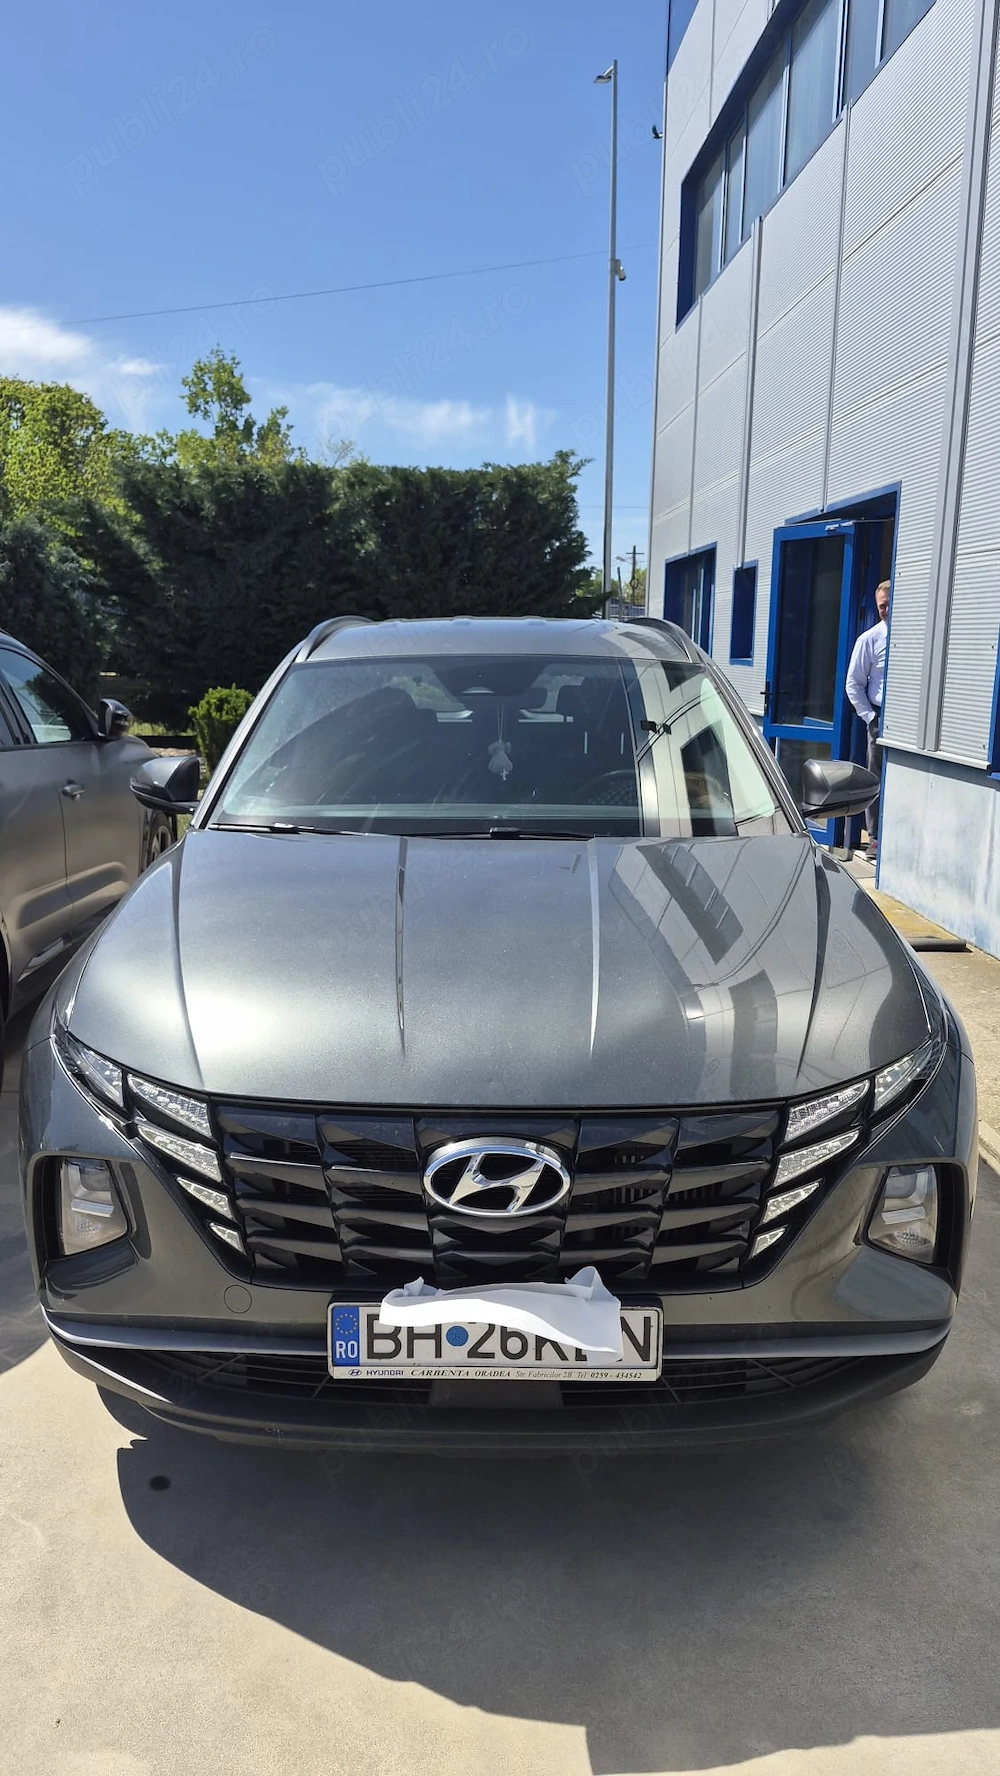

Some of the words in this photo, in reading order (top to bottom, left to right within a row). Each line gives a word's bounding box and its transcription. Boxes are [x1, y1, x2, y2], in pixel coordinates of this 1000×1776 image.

[366, 1313, 442, 1360] BH
[335, 1340, 358, 1359] RO
[411, 1369, 469, 1377] CARBENTA
[590, 1371, 609, 1379] 0259
[615, 1371, 643, 1379] 434542
